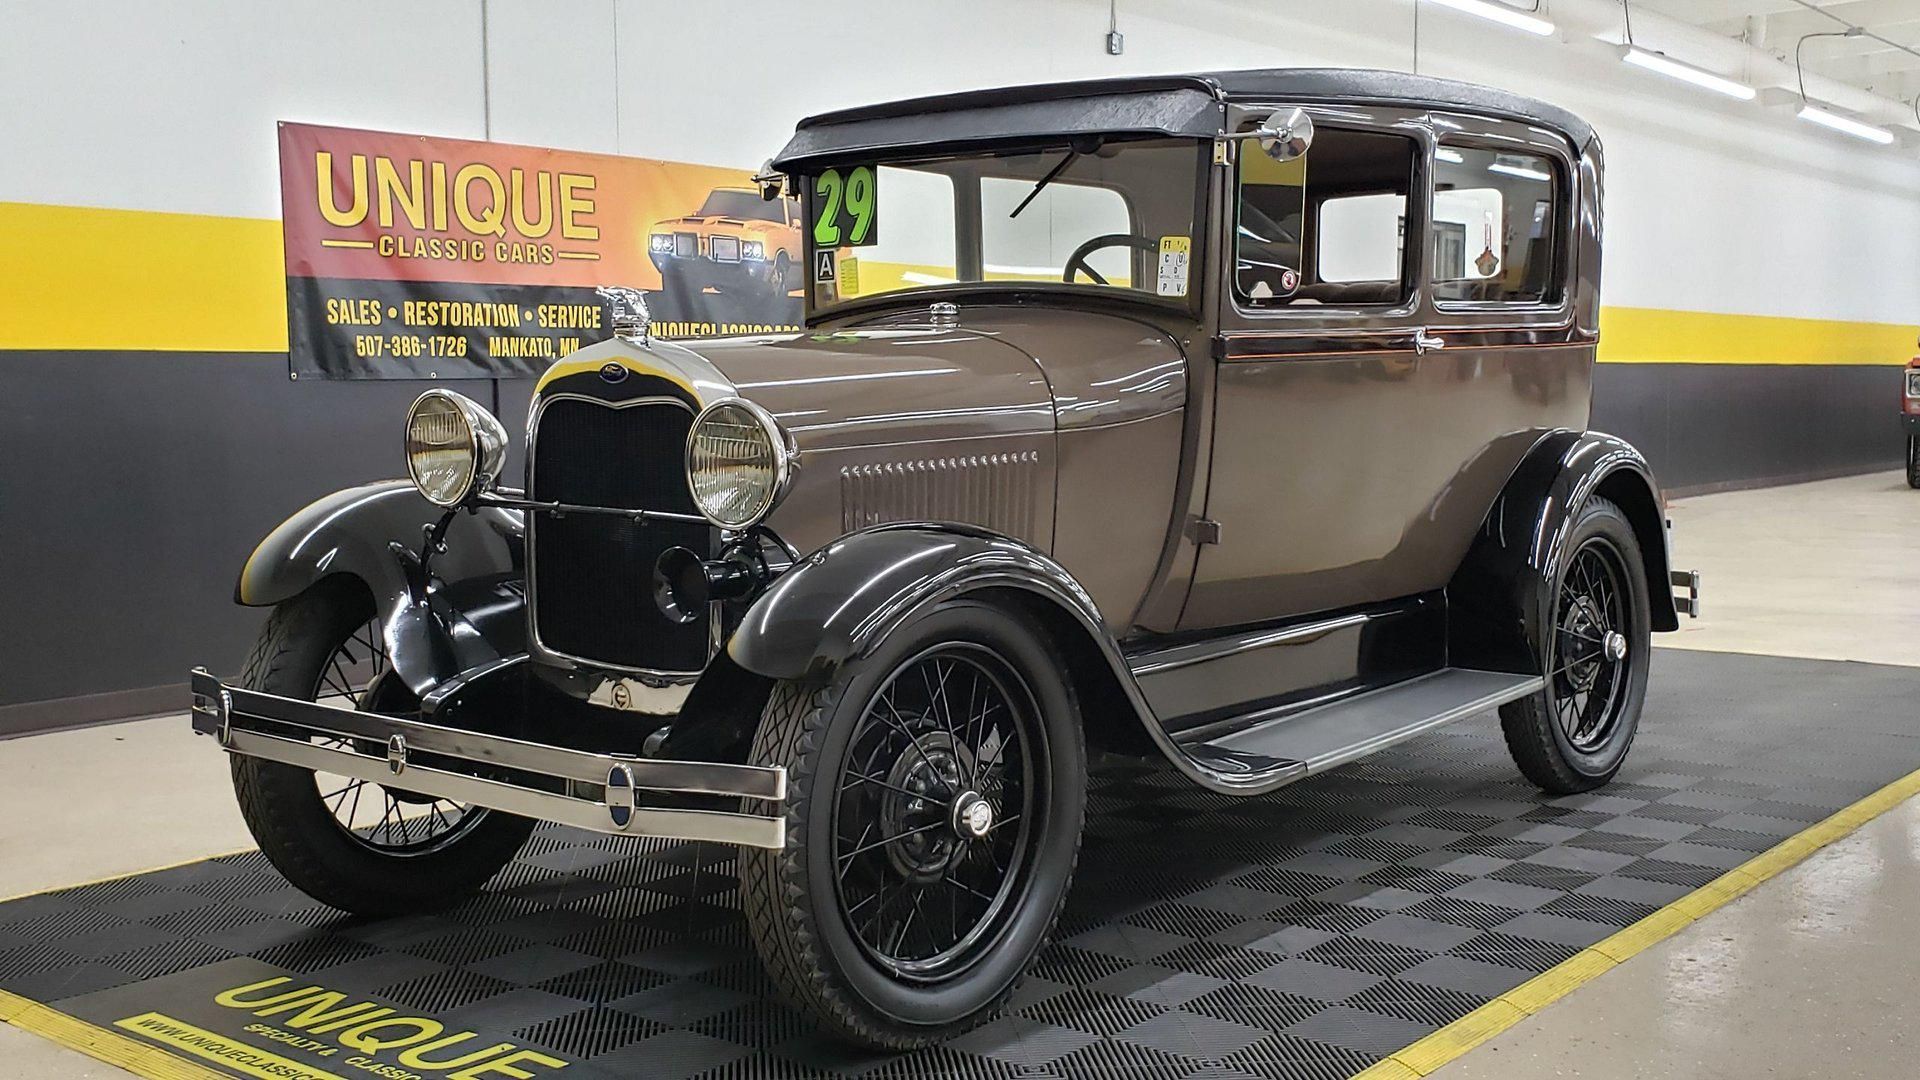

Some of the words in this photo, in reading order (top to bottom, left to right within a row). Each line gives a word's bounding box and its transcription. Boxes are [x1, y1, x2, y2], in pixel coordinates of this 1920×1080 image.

[315, 151, 599, 240] UNIQUE
[814, 165, 876, 246] 29
[379, 235, 486, 262] CLASSIC
[495, 242, 554, 264] CARS
[819, 253, 833, 276] A
[327, 298, 382, 326] SALES
[404, 301, 520, 328] RESTORATION
[538, 304, 602, 329] SERVICE
[356, 335, 467, 358] 507-386-1726
[489, 336, 556, 360] MANKATO,
[243, 1022, 327, 1052] SPECIALTY
